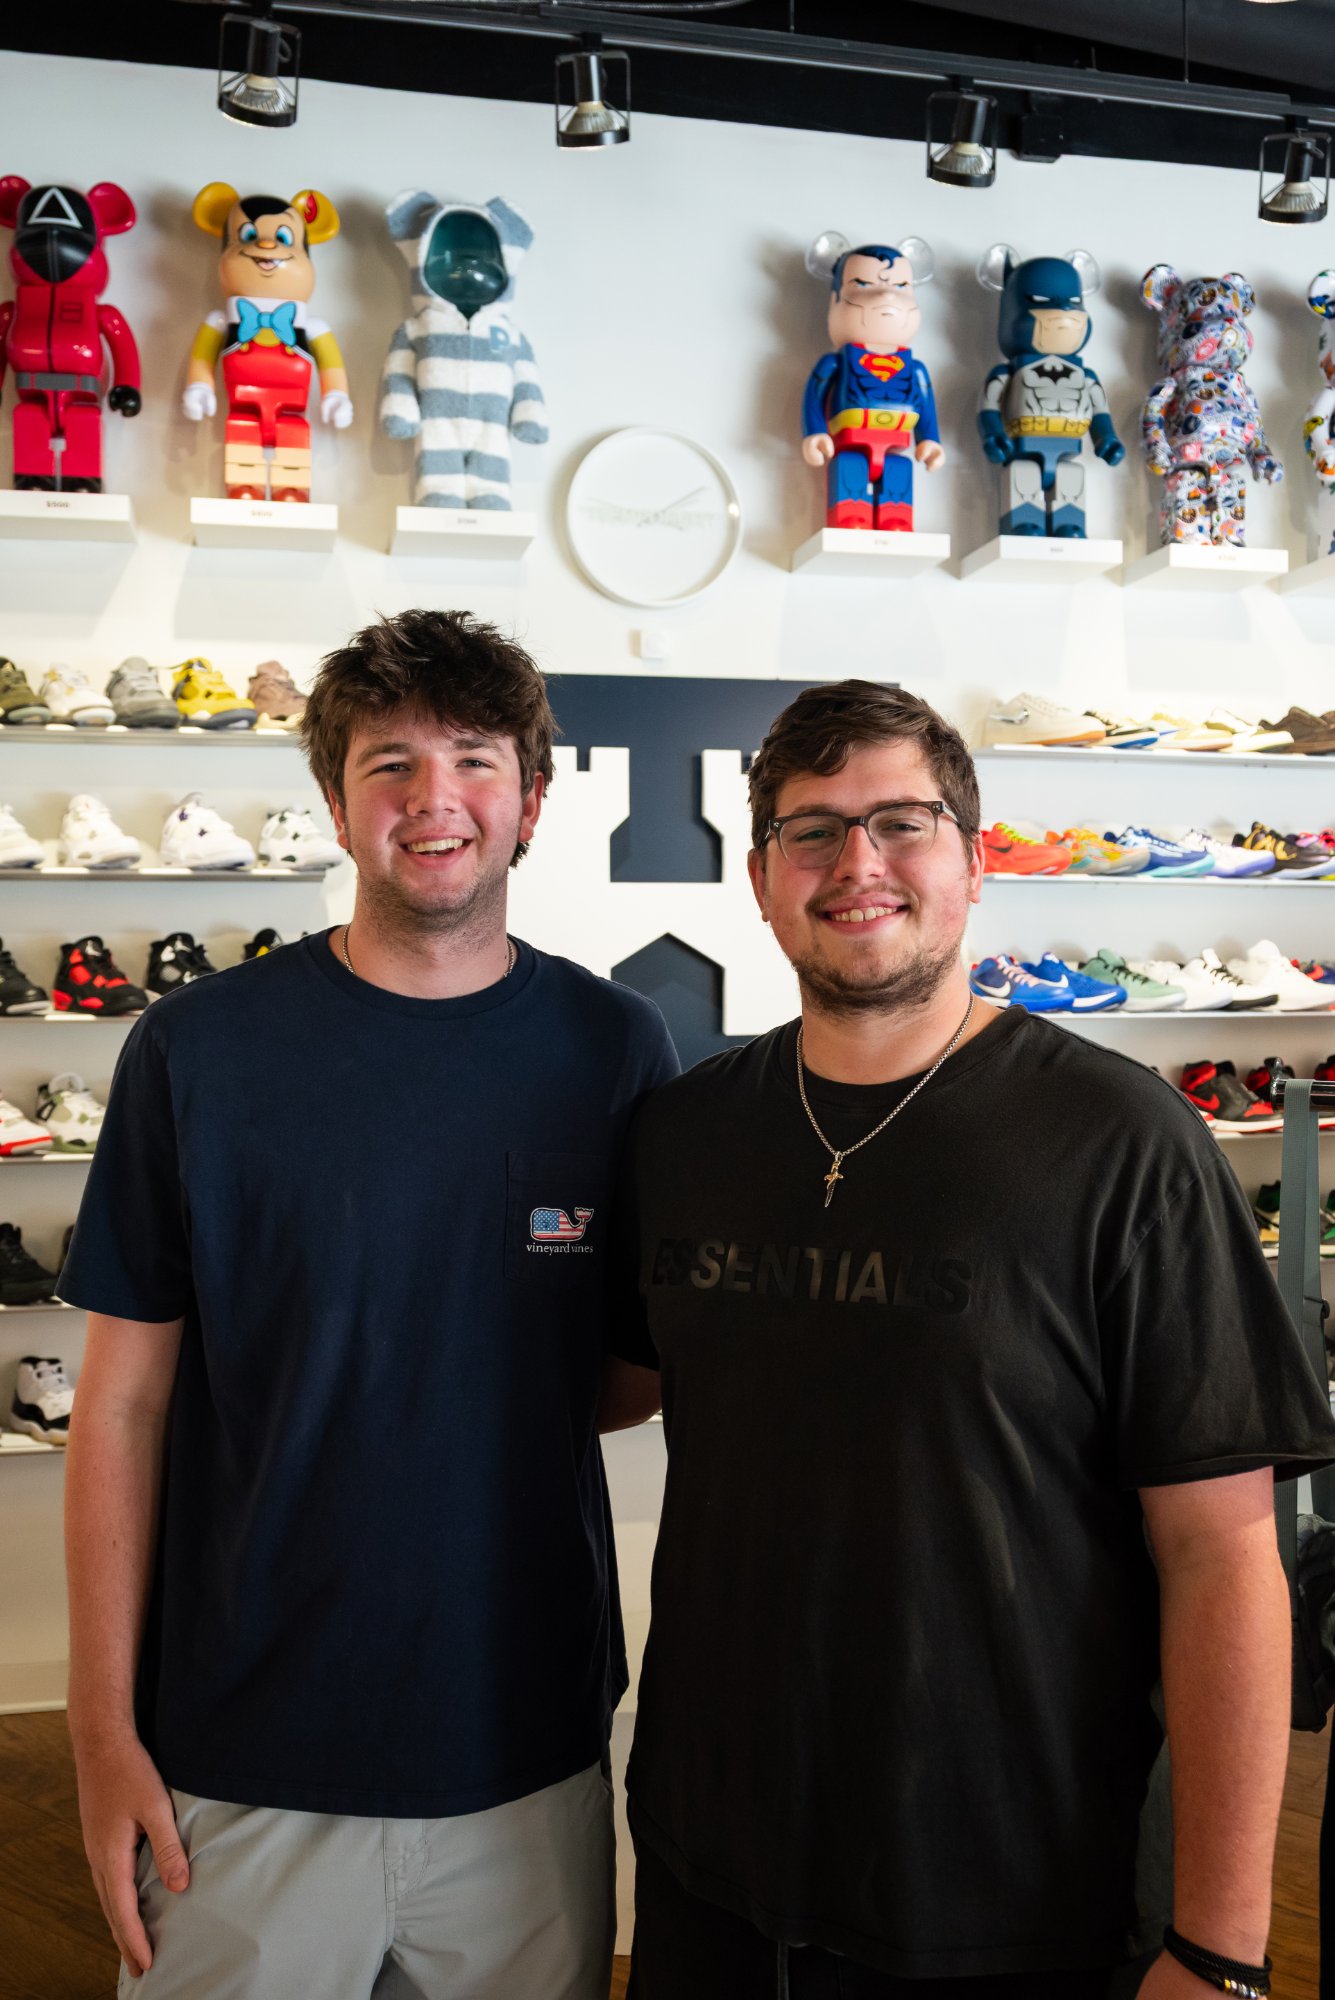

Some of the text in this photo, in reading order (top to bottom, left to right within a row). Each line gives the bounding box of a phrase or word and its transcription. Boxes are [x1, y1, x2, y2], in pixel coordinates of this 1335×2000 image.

[526, 1242, 594, 1256] vineyard vines
[651, 1237, 973, 1314] ESSENTIALS
